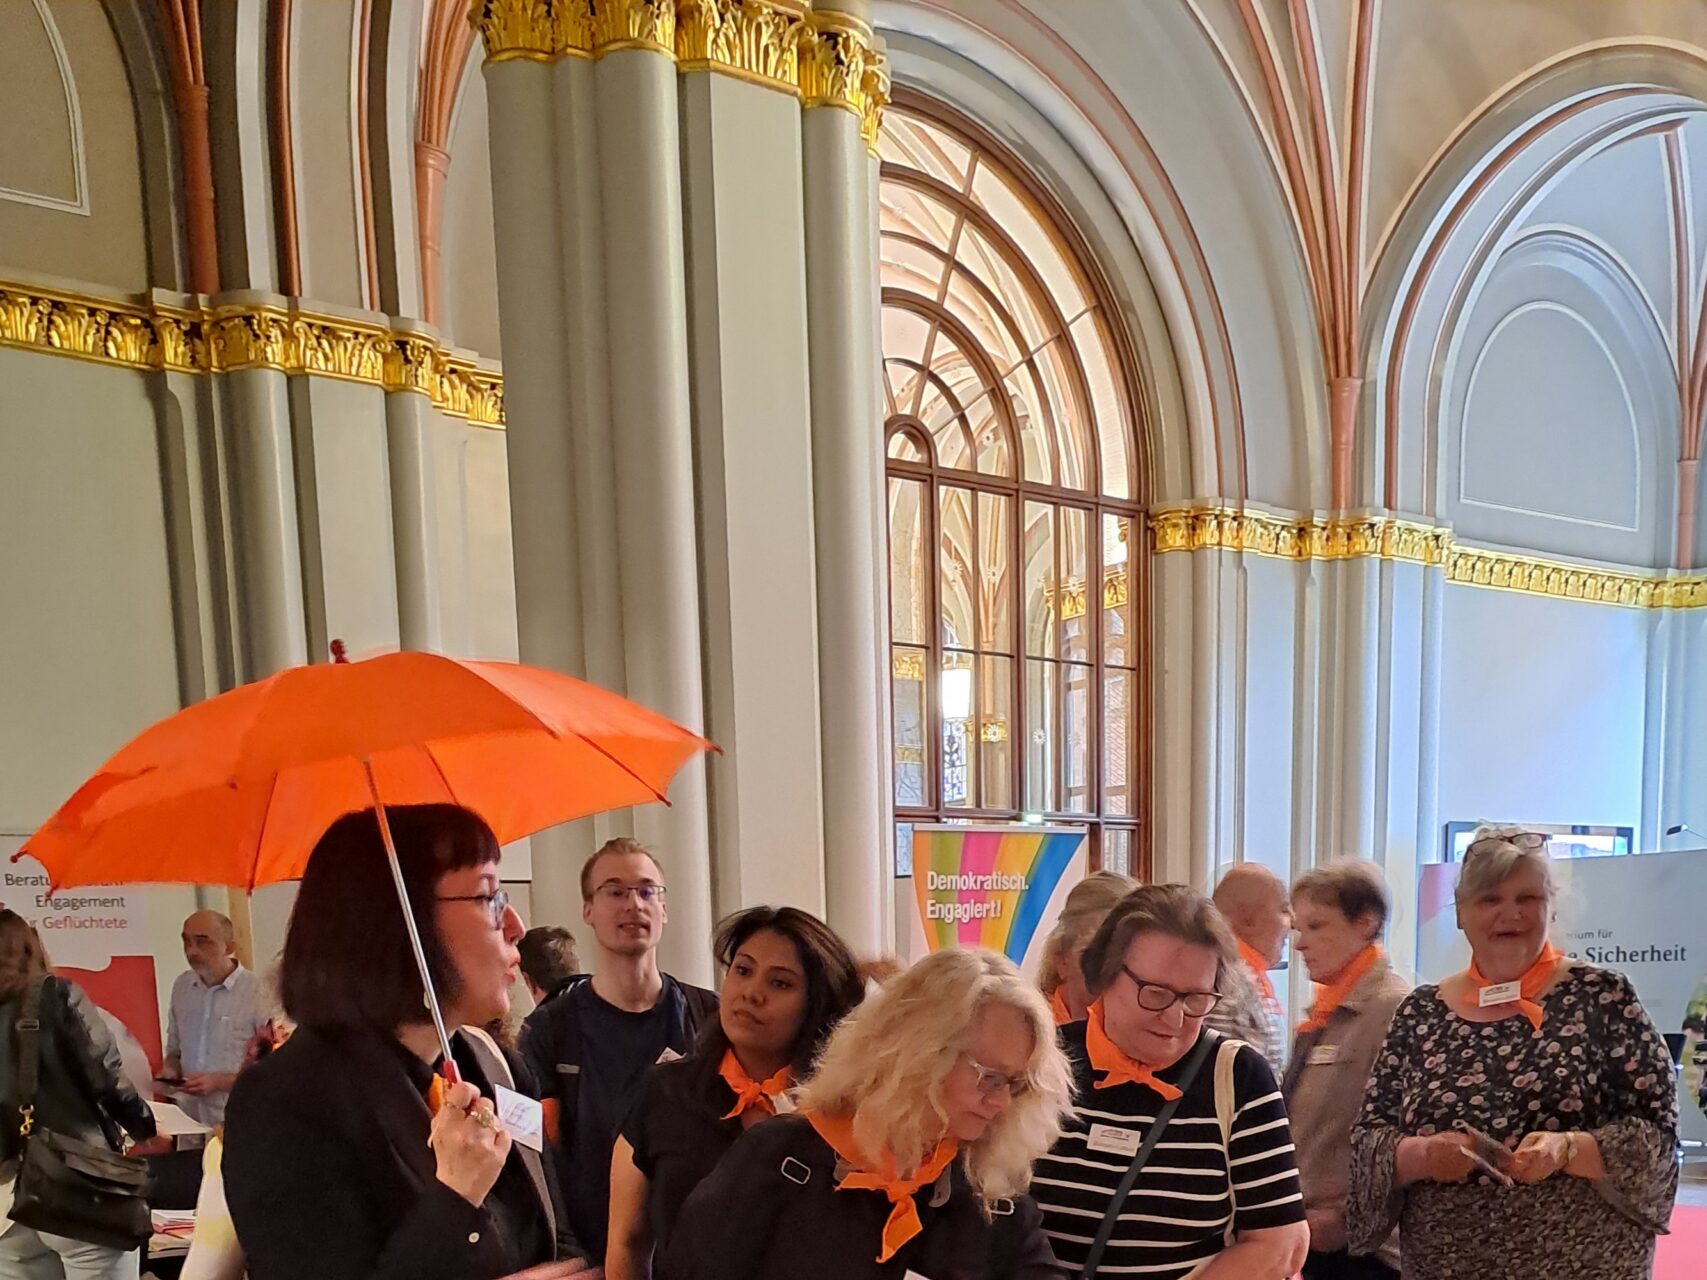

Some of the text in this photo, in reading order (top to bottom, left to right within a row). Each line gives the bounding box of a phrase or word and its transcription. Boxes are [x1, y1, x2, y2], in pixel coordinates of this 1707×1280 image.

[927, 870, 1030, 891] Demokratisch.
[35, 894, 126, 911] Engagement
[926, 899, 1002, 923] Engagiert!
[42, 915, 128, 929] Geflüchtete
[1598, 929, 1613, 939] für
[1585, 944, 1688, 963] Sicherheit
